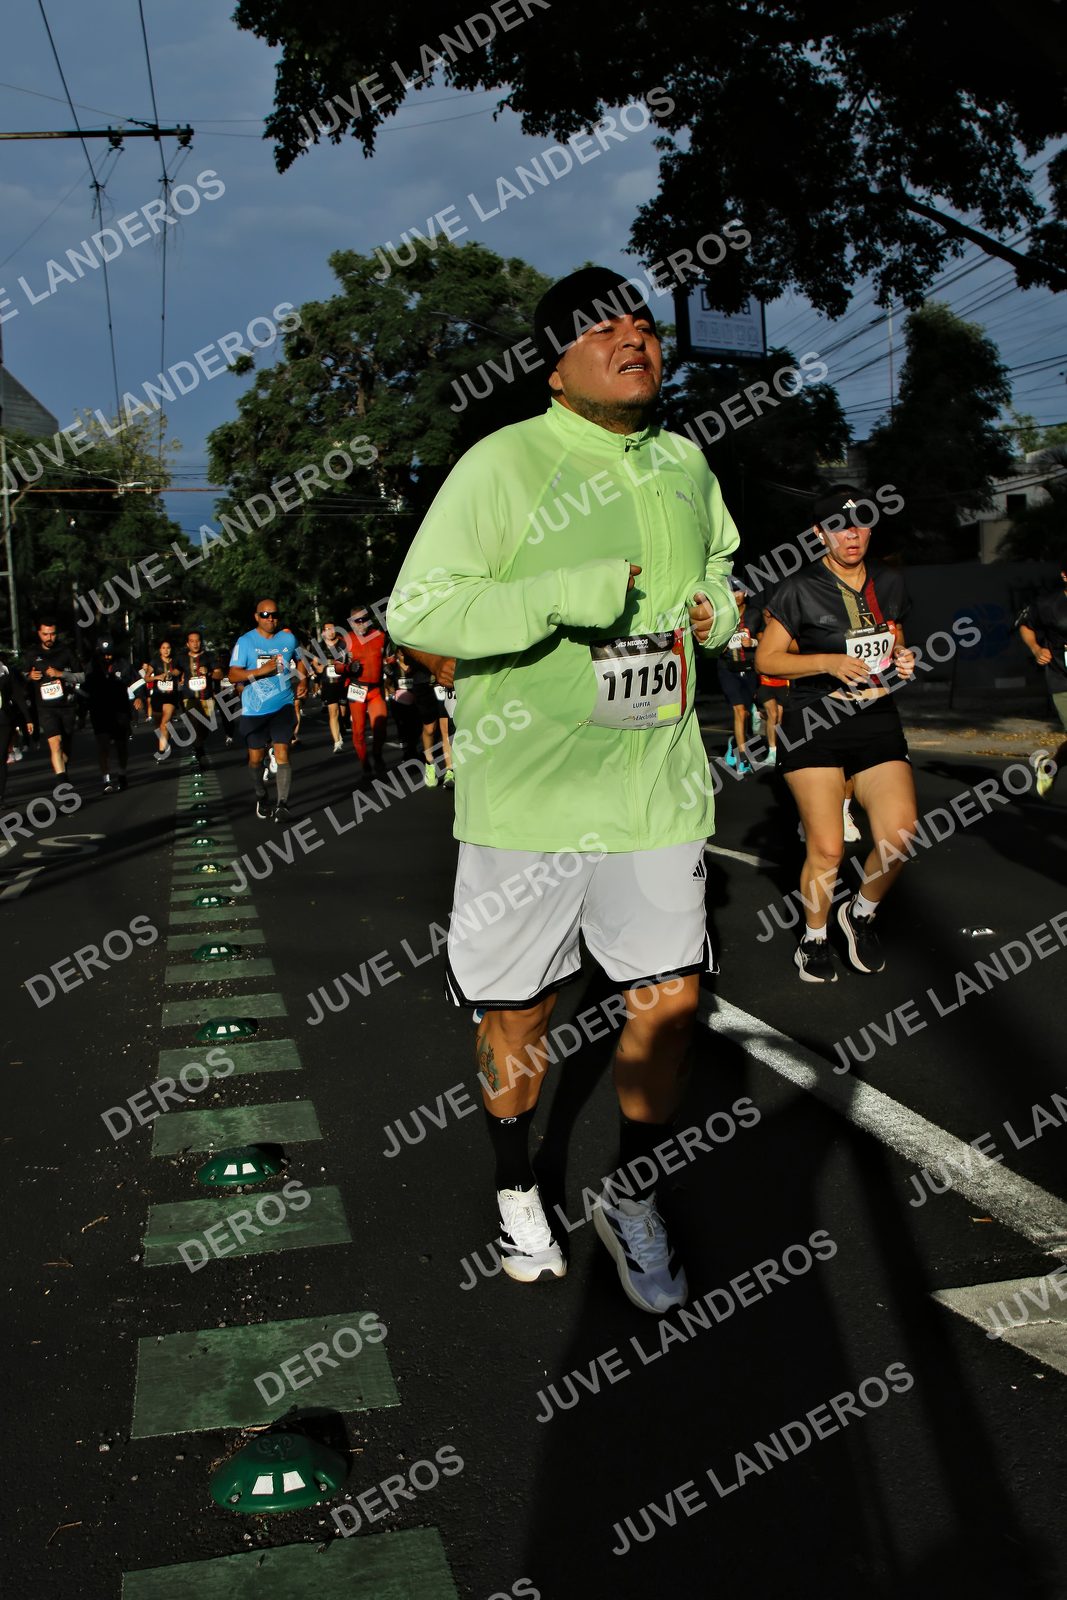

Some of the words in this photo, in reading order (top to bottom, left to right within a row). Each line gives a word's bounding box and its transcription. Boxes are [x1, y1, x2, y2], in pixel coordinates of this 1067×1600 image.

[854, 638, 889, 659] 9330
[602, 660, 678, 701] 11150
[632, 701, 651, 709] LUPITA
